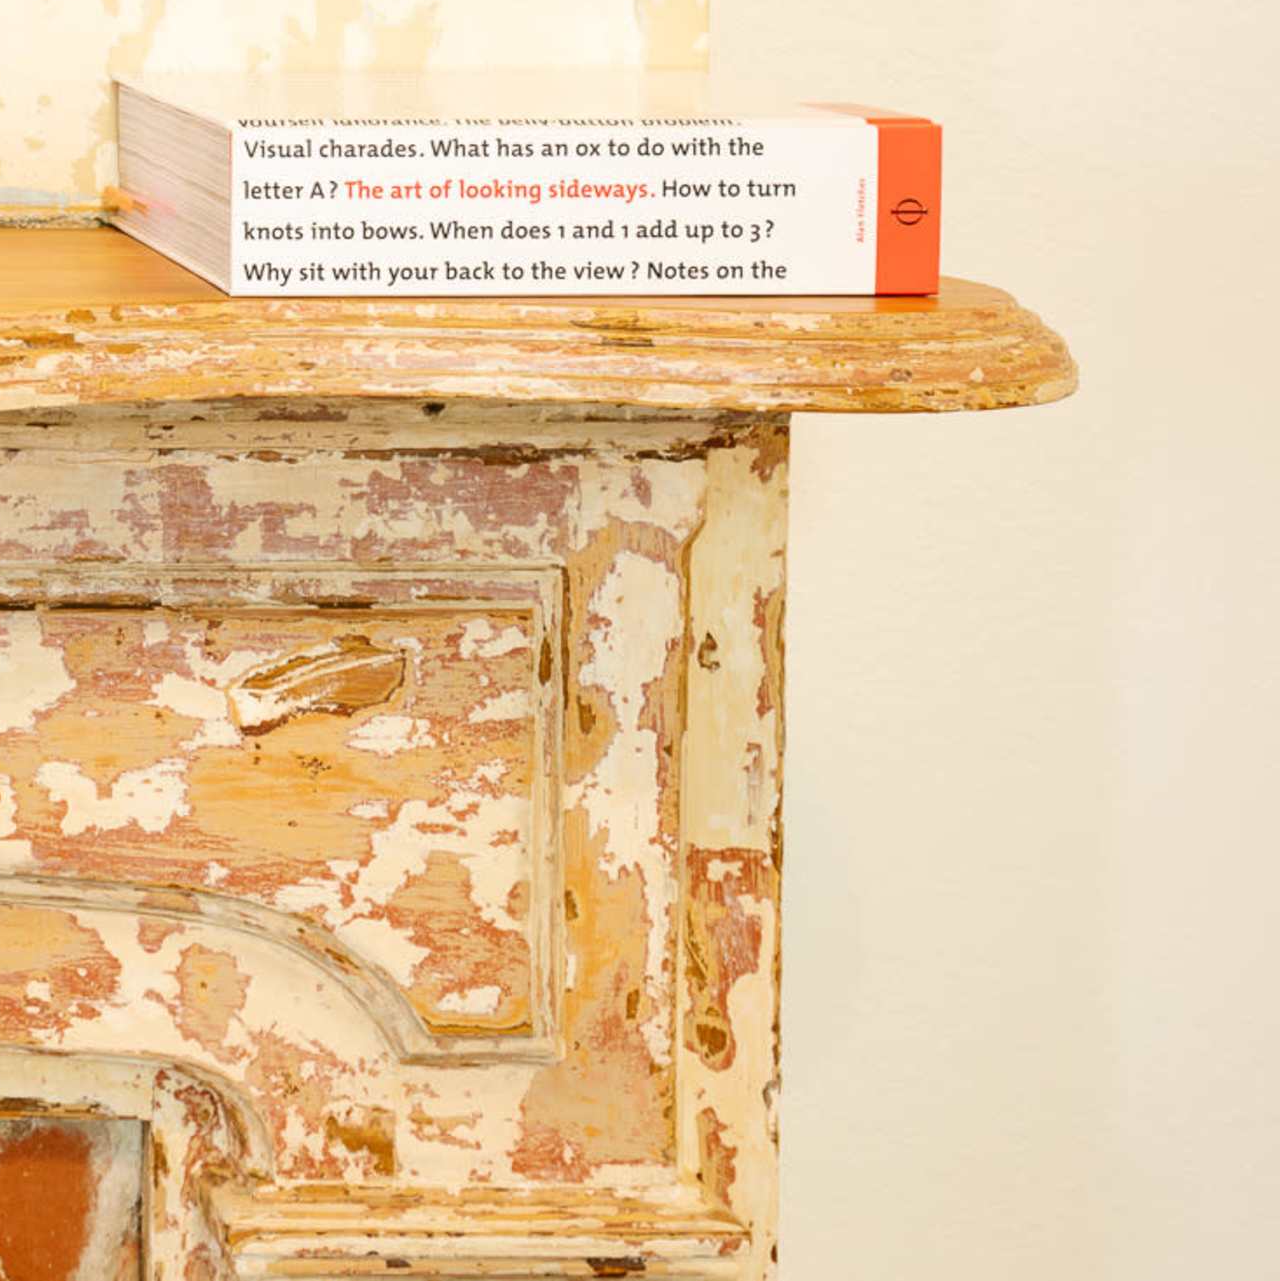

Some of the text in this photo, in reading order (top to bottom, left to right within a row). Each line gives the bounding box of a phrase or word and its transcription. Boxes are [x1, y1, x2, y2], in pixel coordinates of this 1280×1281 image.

[243, 136, 764, 159] Visual charades. What has an ox to do with the
[243, 180, 304, 200] letter
[344, 179, 384, 200] The
[390, 181, 423, 199] art
[429, 179, 453, 199] of
[459, 179, 542, 205] looking
[548, 178, 656, 205] sideways.
[662, 179, 712, 198] How
[717, 179, 741, 198] to
[746, 179, 796, 198] turn
[243, 221, 304, 241] knots
[311, 221, 355, 240] into
[361, 220, 424, 240] bows.
[429, 220, 494, 240] When
[500, 220, 552, 240] does
[557, 225, 565, 239] 1
[572, 219, 615, 240] and
[620, 224, 629, 239] 1
[635, 219, 679, 239] add
[684, 224, 715, 244] up
[720, 220, 744, 239] to
[243, 261, 293, 287] Why
[299, 262, 325, 282] sit
[331, 261, 381, 281] with
[387, 266, 439, 287] your
[444, 260, 495, 281] back
[501, 262, 525, 281] to
[530, 260, 567, 281] the
[647, 261, 710, 281] Notes
[716, 265, 744, 281] on
[750, 259, 787, 280] the
